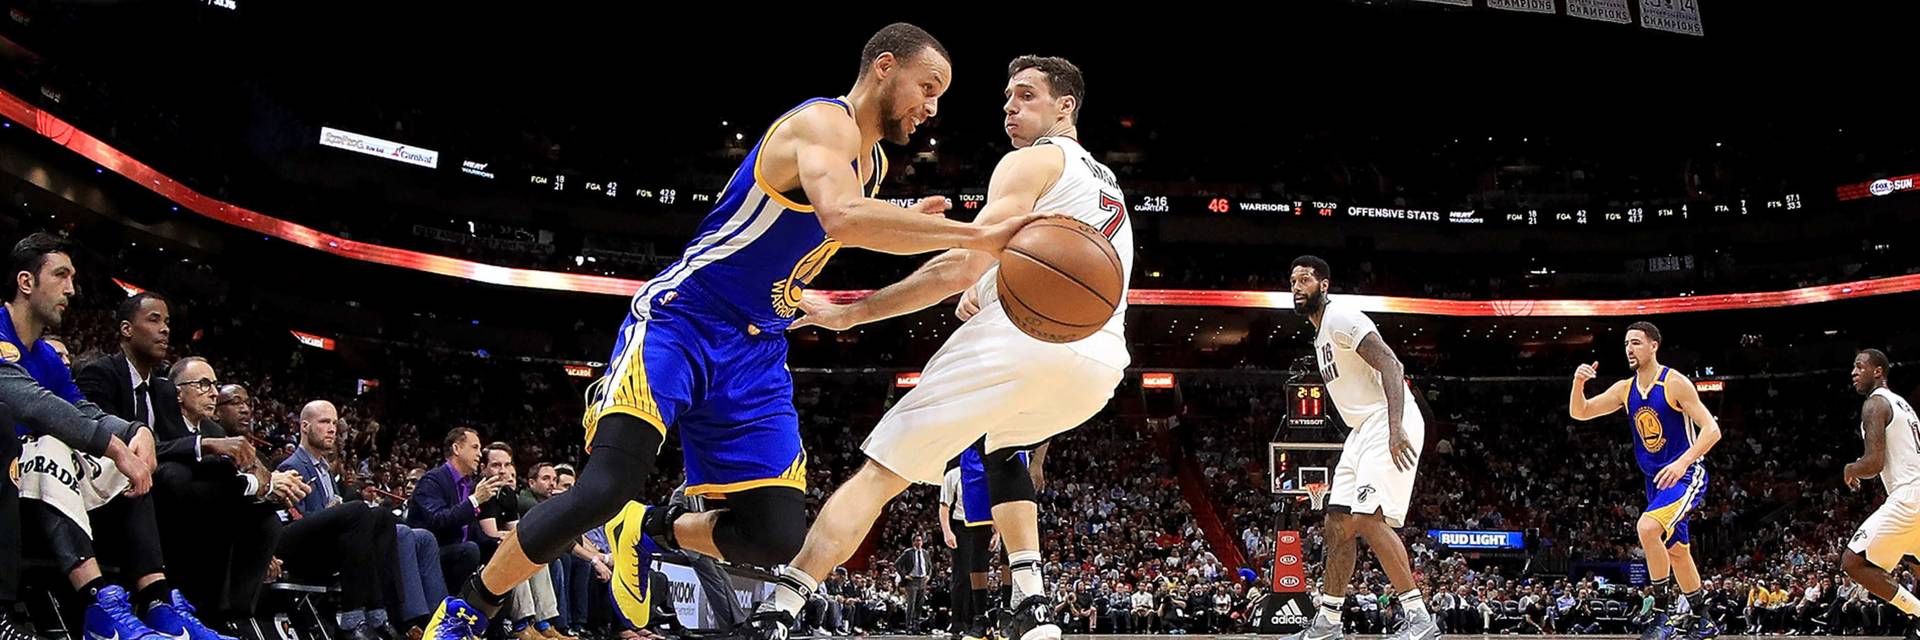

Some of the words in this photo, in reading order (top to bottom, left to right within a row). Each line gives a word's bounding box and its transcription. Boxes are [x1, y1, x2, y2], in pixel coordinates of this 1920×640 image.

[1570, 3, 1628, 20] CHAMPIONS
[1643, 15, 1701, 32] CHAMPIONS
[531, 176, 547, 184] FGM
[555, 175, 565, 183] 18
[1894, 178, 1913, 190] SUN
[554, 182, 564, 190] 21
[585, 182, 601, 191] FGA
[607, 182, 617, 190] 42
[1143, 196, 1167, 207] 2:16
[1208, 198, 1229, 213] 46
[1240, 202, 1290, 212] WARRIORS
[1099, 189, 1126, 241] 7
[1347, 206, 1405, 219] OFFENSIVE
[1406, 209, 1440, 221] STATS
[1506, 213, 1523, 221] FGM
[1576, 209, 1587, 217] 42
[1528, 217, 1537, 225] 21
[771, 279, 797, 318] WARRIO
[1321, 341, 1333, 365] 16
[1297, 387, 1321, 398] 2:16
[1302, 399, 1318, 415] 11
[1441, 533, 1468, 545] BUD
[1469, 534, 1507, 545] LIGHT
[1271, 616, 1308, 625] adidas
